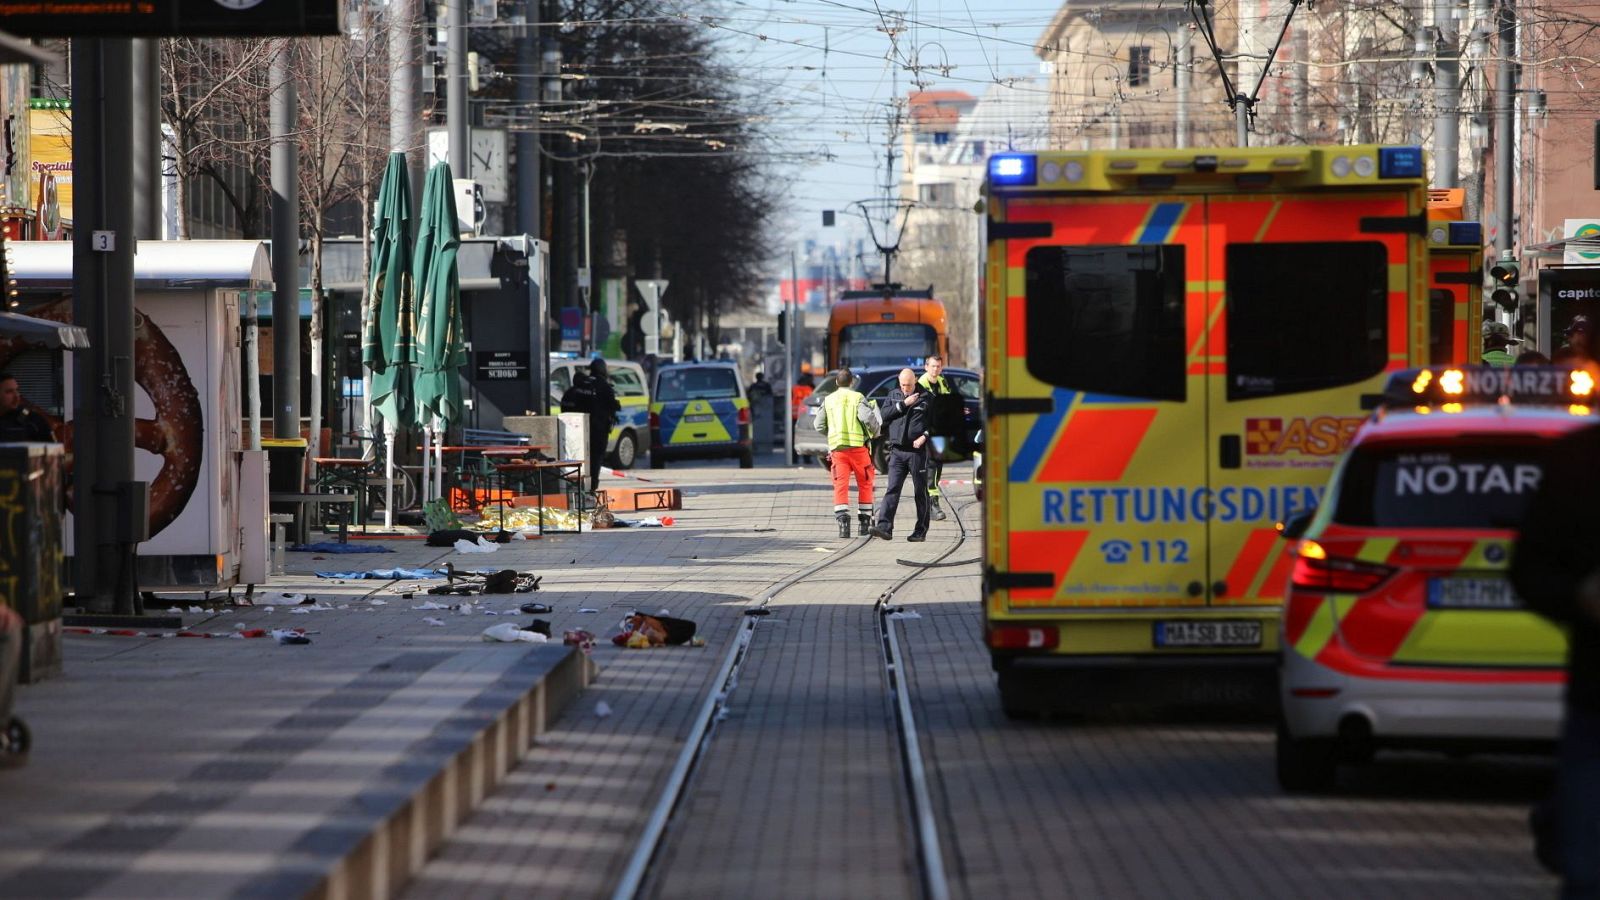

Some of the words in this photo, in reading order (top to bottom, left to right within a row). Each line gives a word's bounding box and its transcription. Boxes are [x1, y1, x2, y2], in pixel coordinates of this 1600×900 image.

[100, 234, 108, 250] 3
[488, 369, 518, 378] SCHOKO
[1467, 371, 1567, 395] NOTARZT
[1140, 540, 1190, 564] 112
